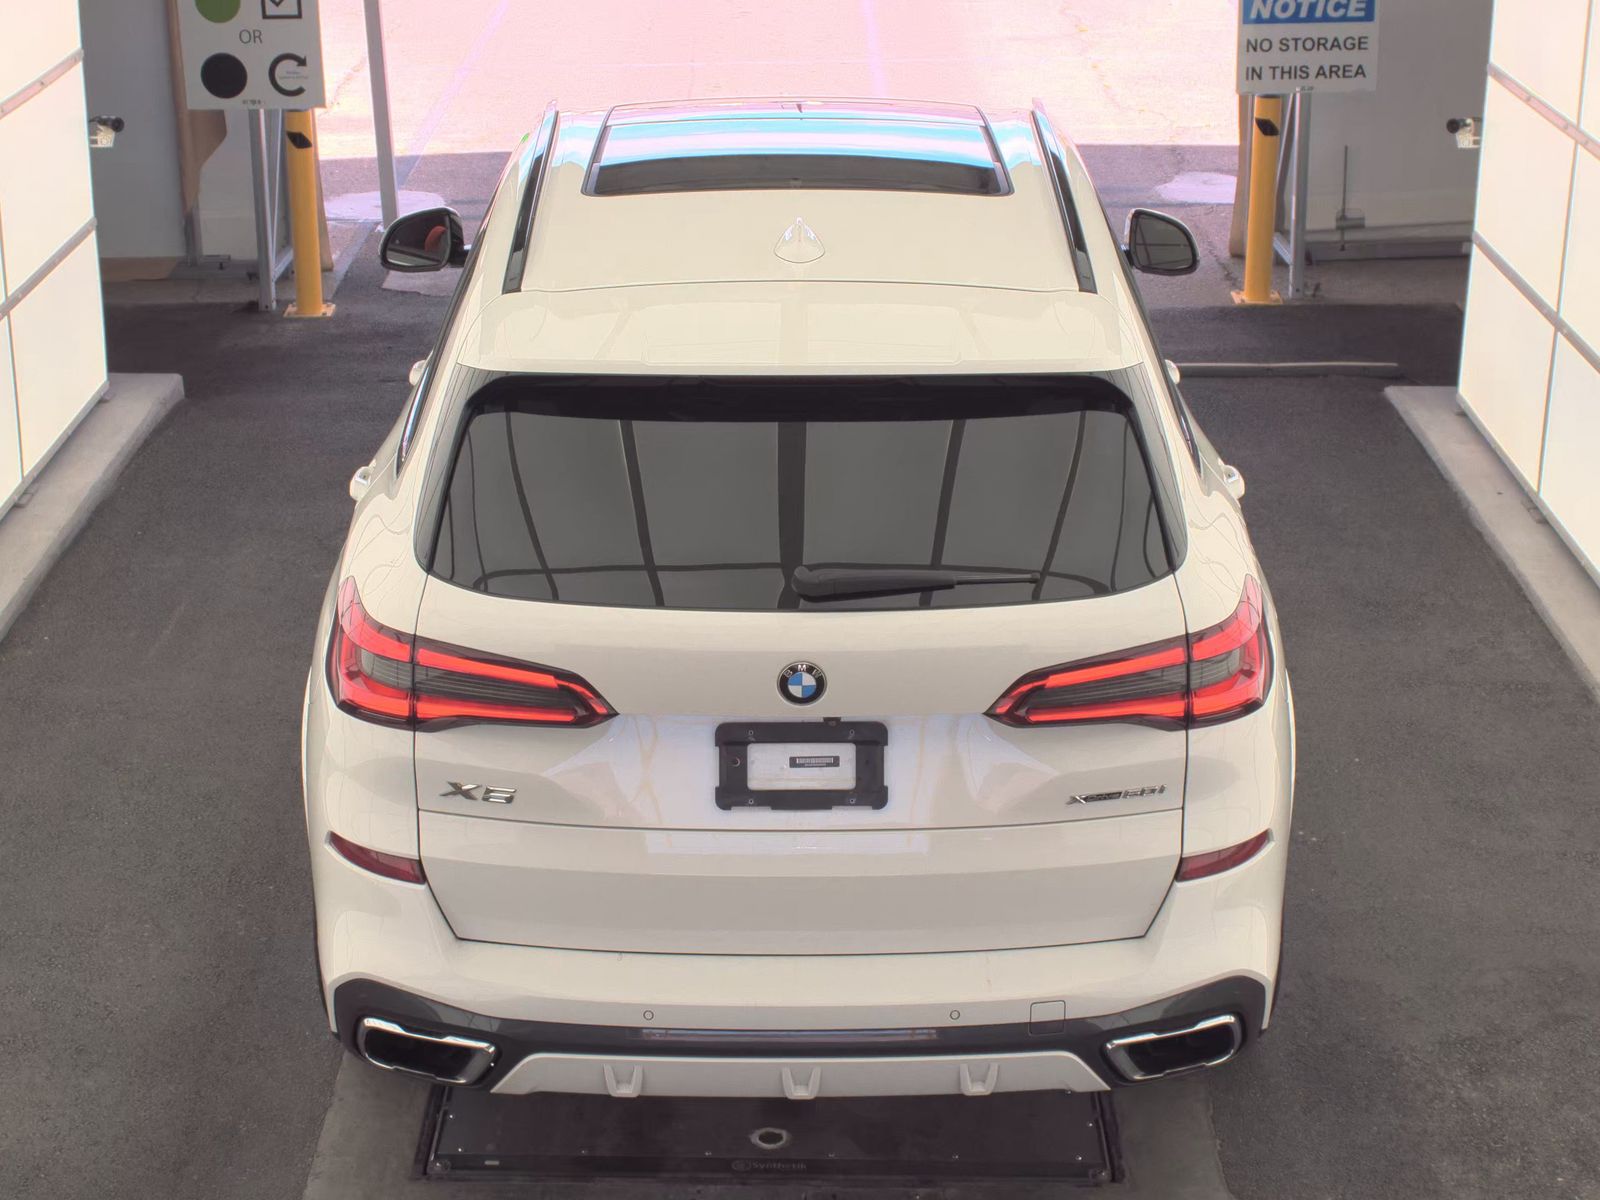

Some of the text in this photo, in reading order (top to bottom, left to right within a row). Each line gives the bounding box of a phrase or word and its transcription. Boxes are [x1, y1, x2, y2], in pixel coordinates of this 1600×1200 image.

[1250, 0, 1366, 19] NOTICE
[239, 29, 263, 44] OR
[1246, 36, 1369, 52] NO STORAGE
[1245, 64, 1366, 80] IN THIS AREA
